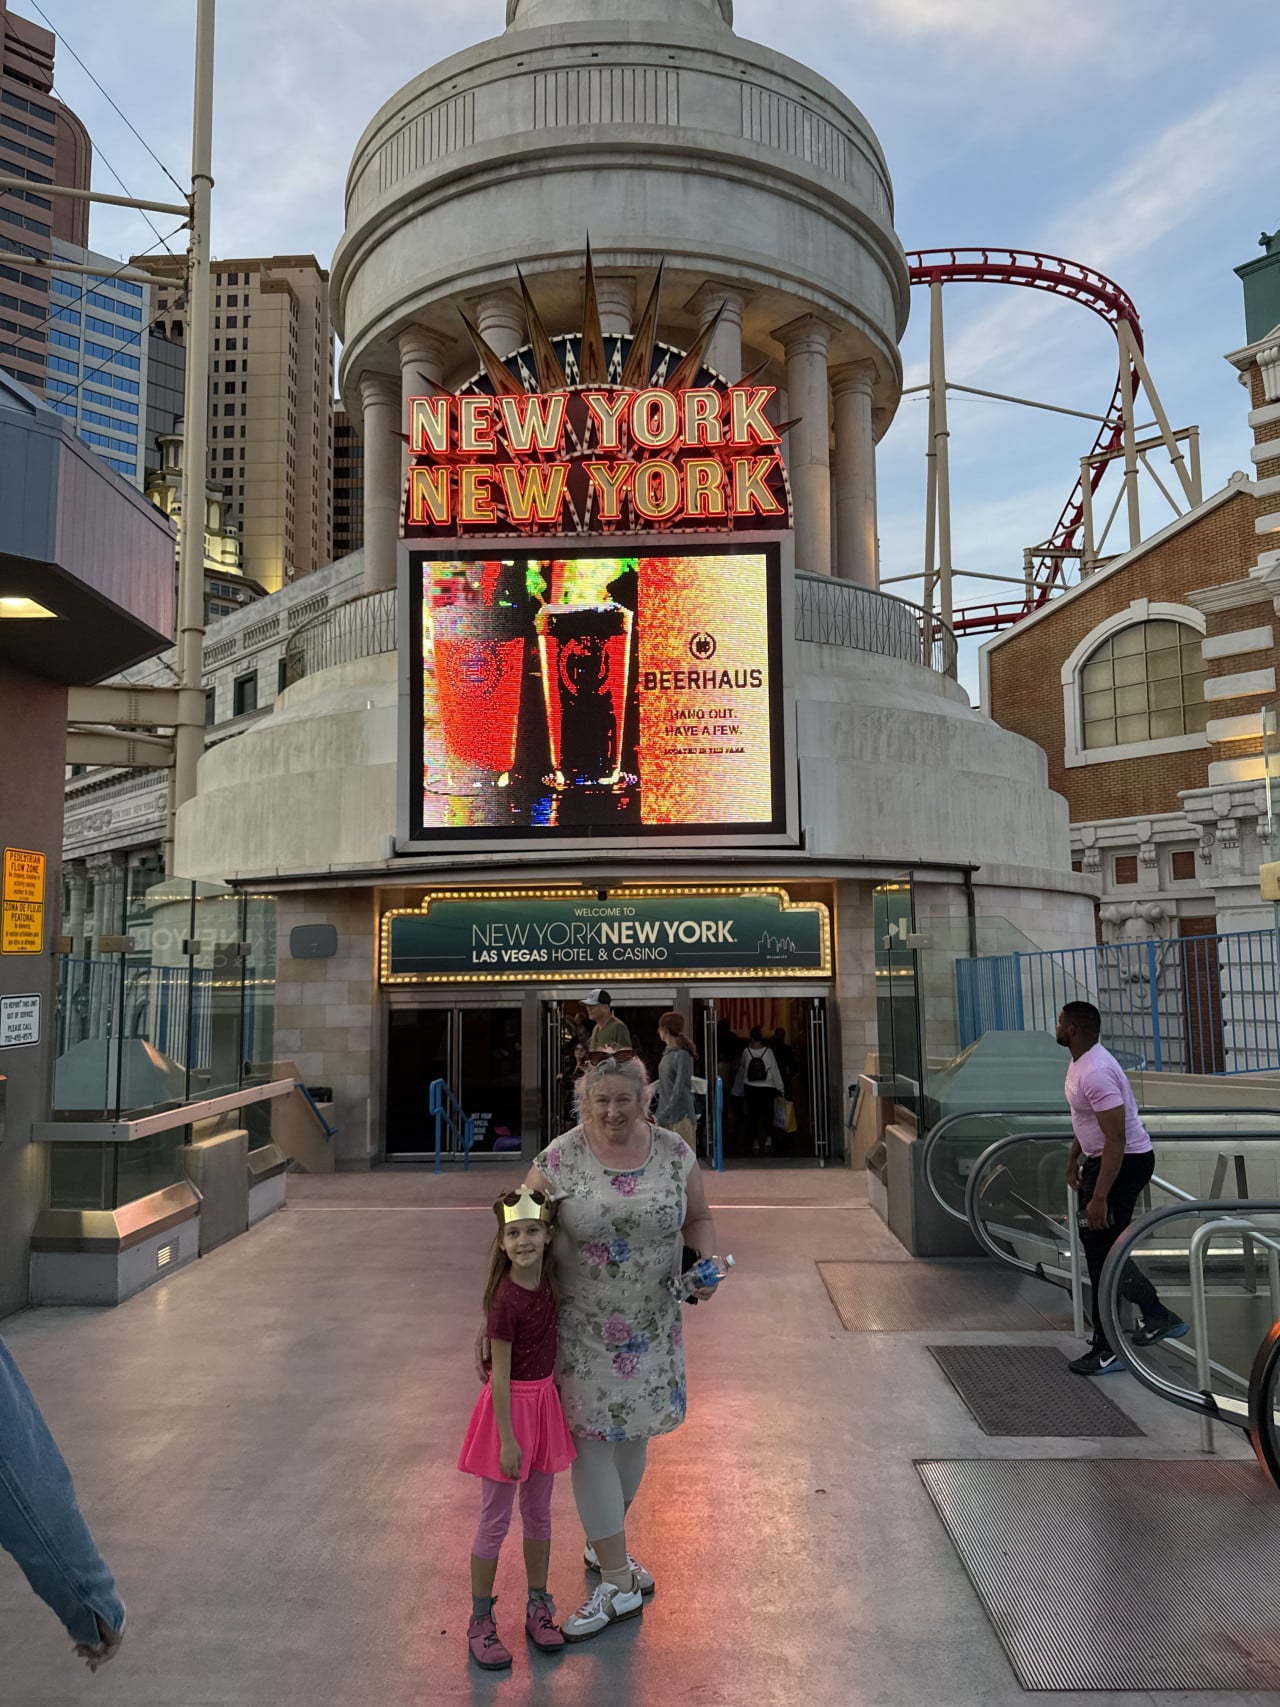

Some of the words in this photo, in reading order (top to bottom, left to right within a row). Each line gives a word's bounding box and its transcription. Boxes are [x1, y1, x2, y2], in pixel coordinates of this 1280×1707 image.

[407, 393, 570, 454] NEW
[581, 386, 783, 453] YORK
[408, 462, 571, 526] NEW
[582, 455, 785, 520] YORK
[644, 669, 763, 691] BEERHAUS
[665, 725, 699, 737] HAVE
[702, 725, 711, 736] A
[9, 852, 41, 864] PEDESTRIAN
[10, 862, 25, 872] FLOW
[26, 863, 40, 874] ZONE
[19, 903, 26, 912] DE
[574, 907, 621, 917] WELCOME
[623, 907, 636, 916] TO
[10, 912, 35, 923] PEATONAL
[472, 922, 530, 947] NEW
[533, 921, 601, 946] YORK
[600, 921, 661, 945] NEW
[472, 949, 498, 963] LAS
[501, 948, 548, 962] VEGAS
[551, 948, 593, 962] HOTEL
[598, 948, 609, 961] &
[612, 946, 668, 961] CASINO
[8, 1023, 22, 1032] PLEASE
[22, 1023, 32, 1031] CALL
